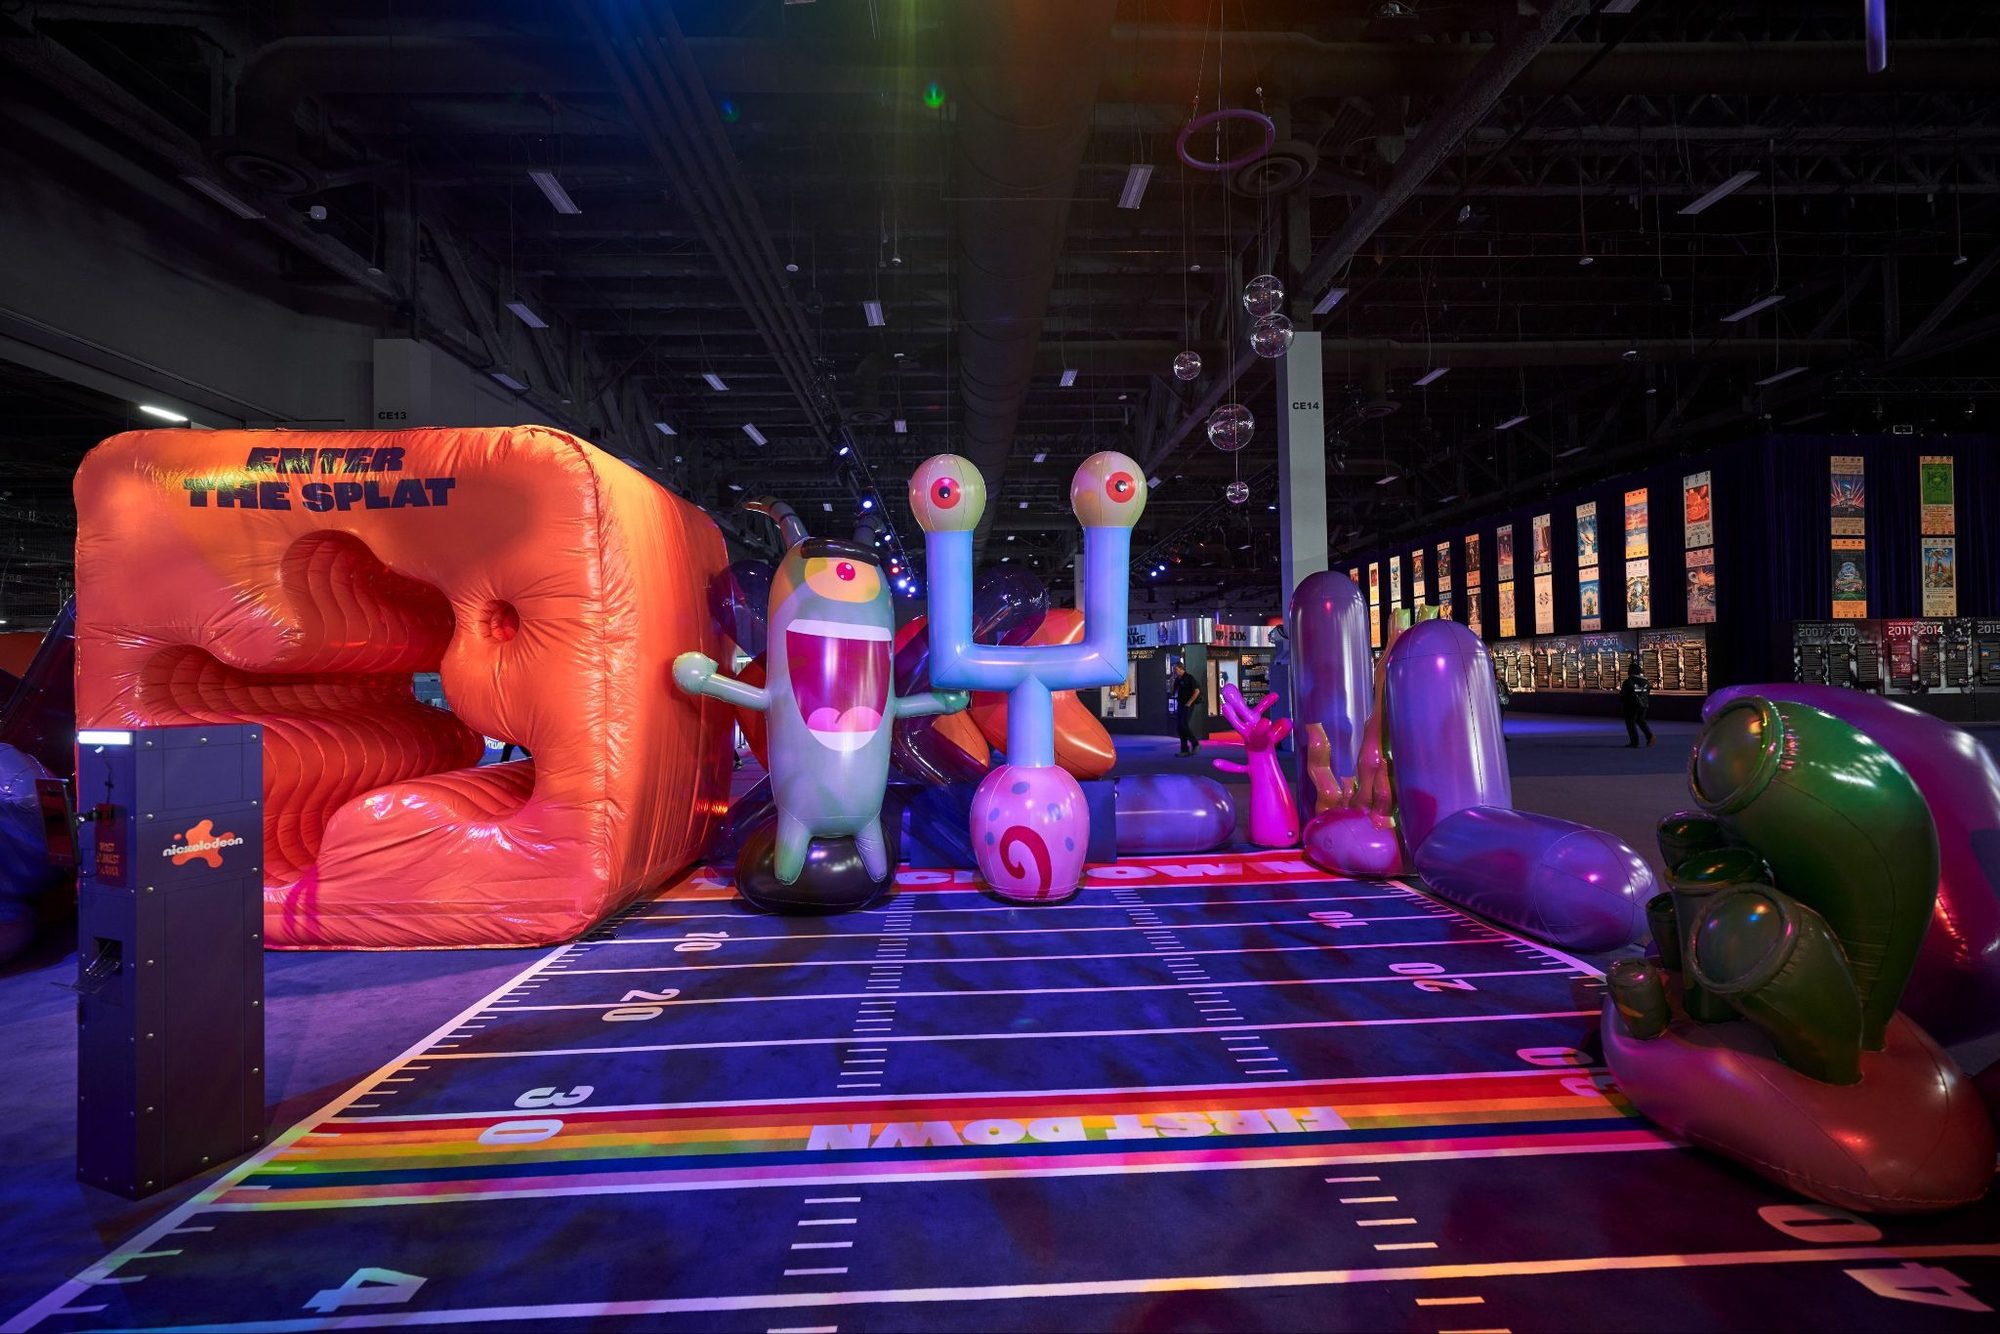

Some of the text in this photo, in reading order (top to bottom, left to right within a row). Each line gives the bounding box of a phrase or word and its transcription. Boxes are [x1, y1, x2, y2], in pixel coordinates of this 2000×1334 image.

[377, 411, 408, 420] CE13
[1292, 401, 1320, 410] CE14
[245, 446, 406, 474] ENTER
[183, 477, 456, 513] THE SPLAT
[1798, 628, 1825, 637] 2007
[1832, 627, 1857, 637] 2010
[1888, 625, 1944, 635] 2011 2014
[162, 836, 244, 857] nickelodeon
[1307, 910, 1369, 929] 10
[673, 931, 730, 952] 10
[1388, 962, 1479, 992] 20
[601, 988, 681, 1022] 20
[477, 1085, 595, 1145] 30
[805, 1106, 1352, 1151] FIRST DOWN
